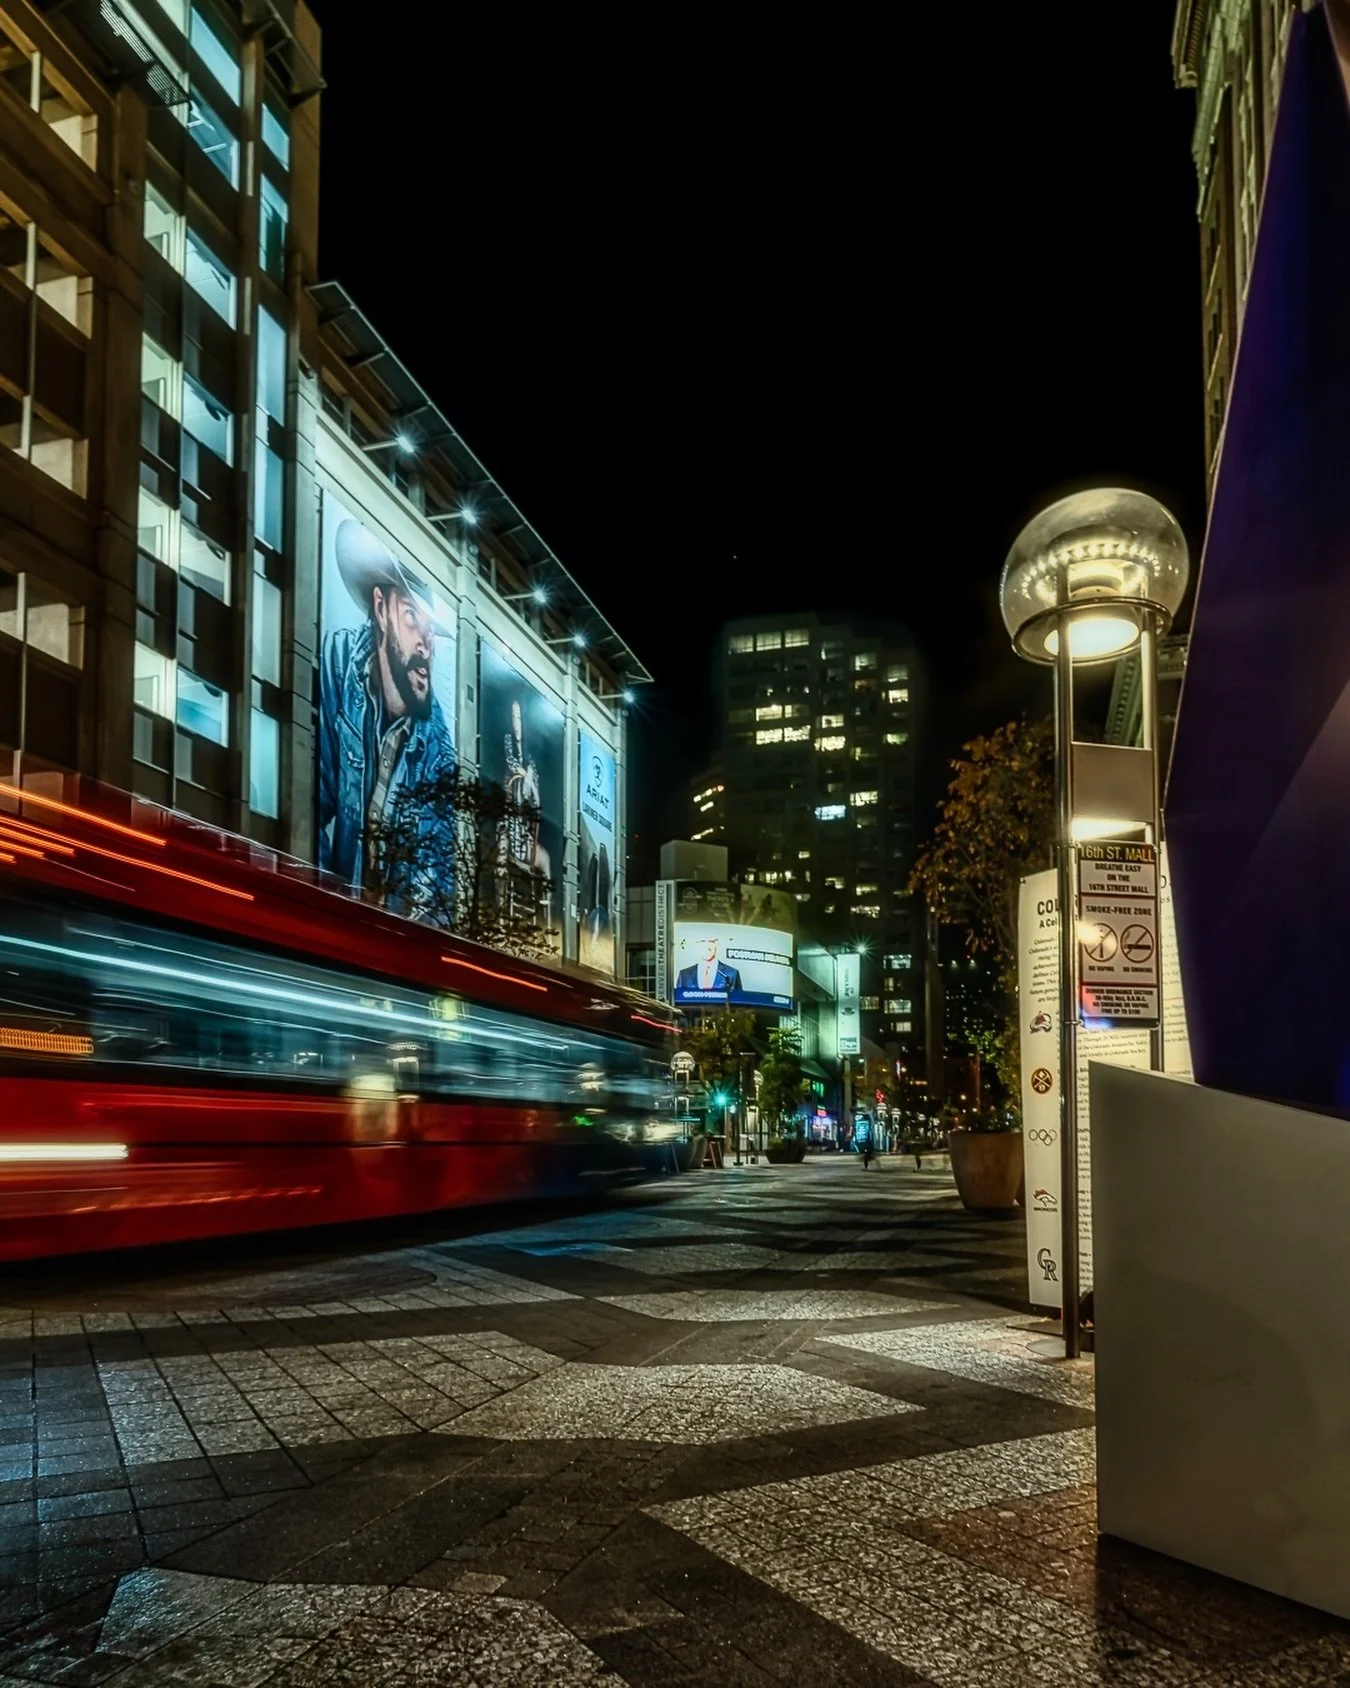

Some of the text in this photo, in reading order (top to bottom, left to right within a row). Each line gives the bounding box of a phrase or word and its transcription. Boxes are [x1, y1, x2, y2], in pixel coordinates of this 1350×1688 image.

[586, 784, 610, 809] ARIAT
[1081, 845, 1155, 862] 16th ST. MALL
[1095, 863, 1124, 872] BREATHE
[1086, 905, 1152, 916] SMOKE-FREE ZONE
